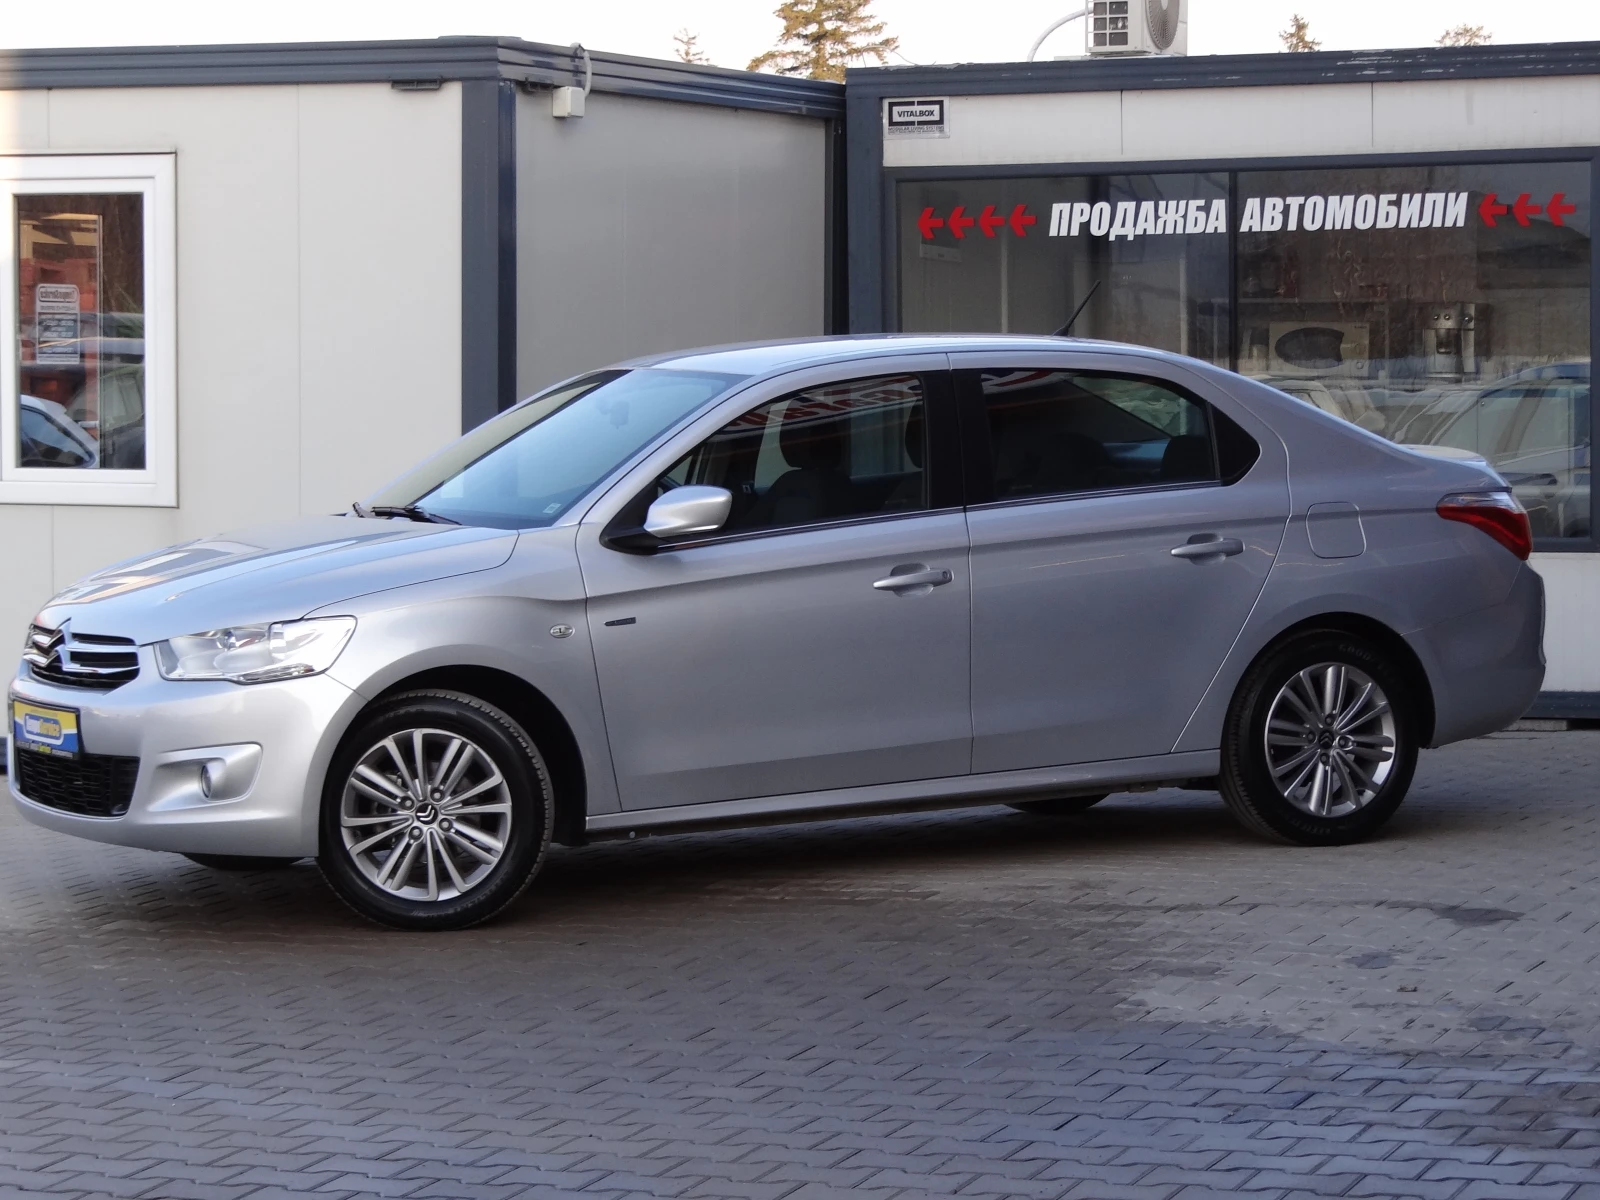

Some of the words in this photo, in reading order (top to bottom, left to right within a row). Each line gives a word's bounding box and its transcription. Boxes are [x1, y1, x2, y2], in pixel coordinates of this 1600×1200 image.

[897, 110, 935, 118] VITALBOX
[1048, 199, 1227, 241] ПРОДАЖБА
[1239, 191, 1469, 233] АВТОМОБИЛИ
